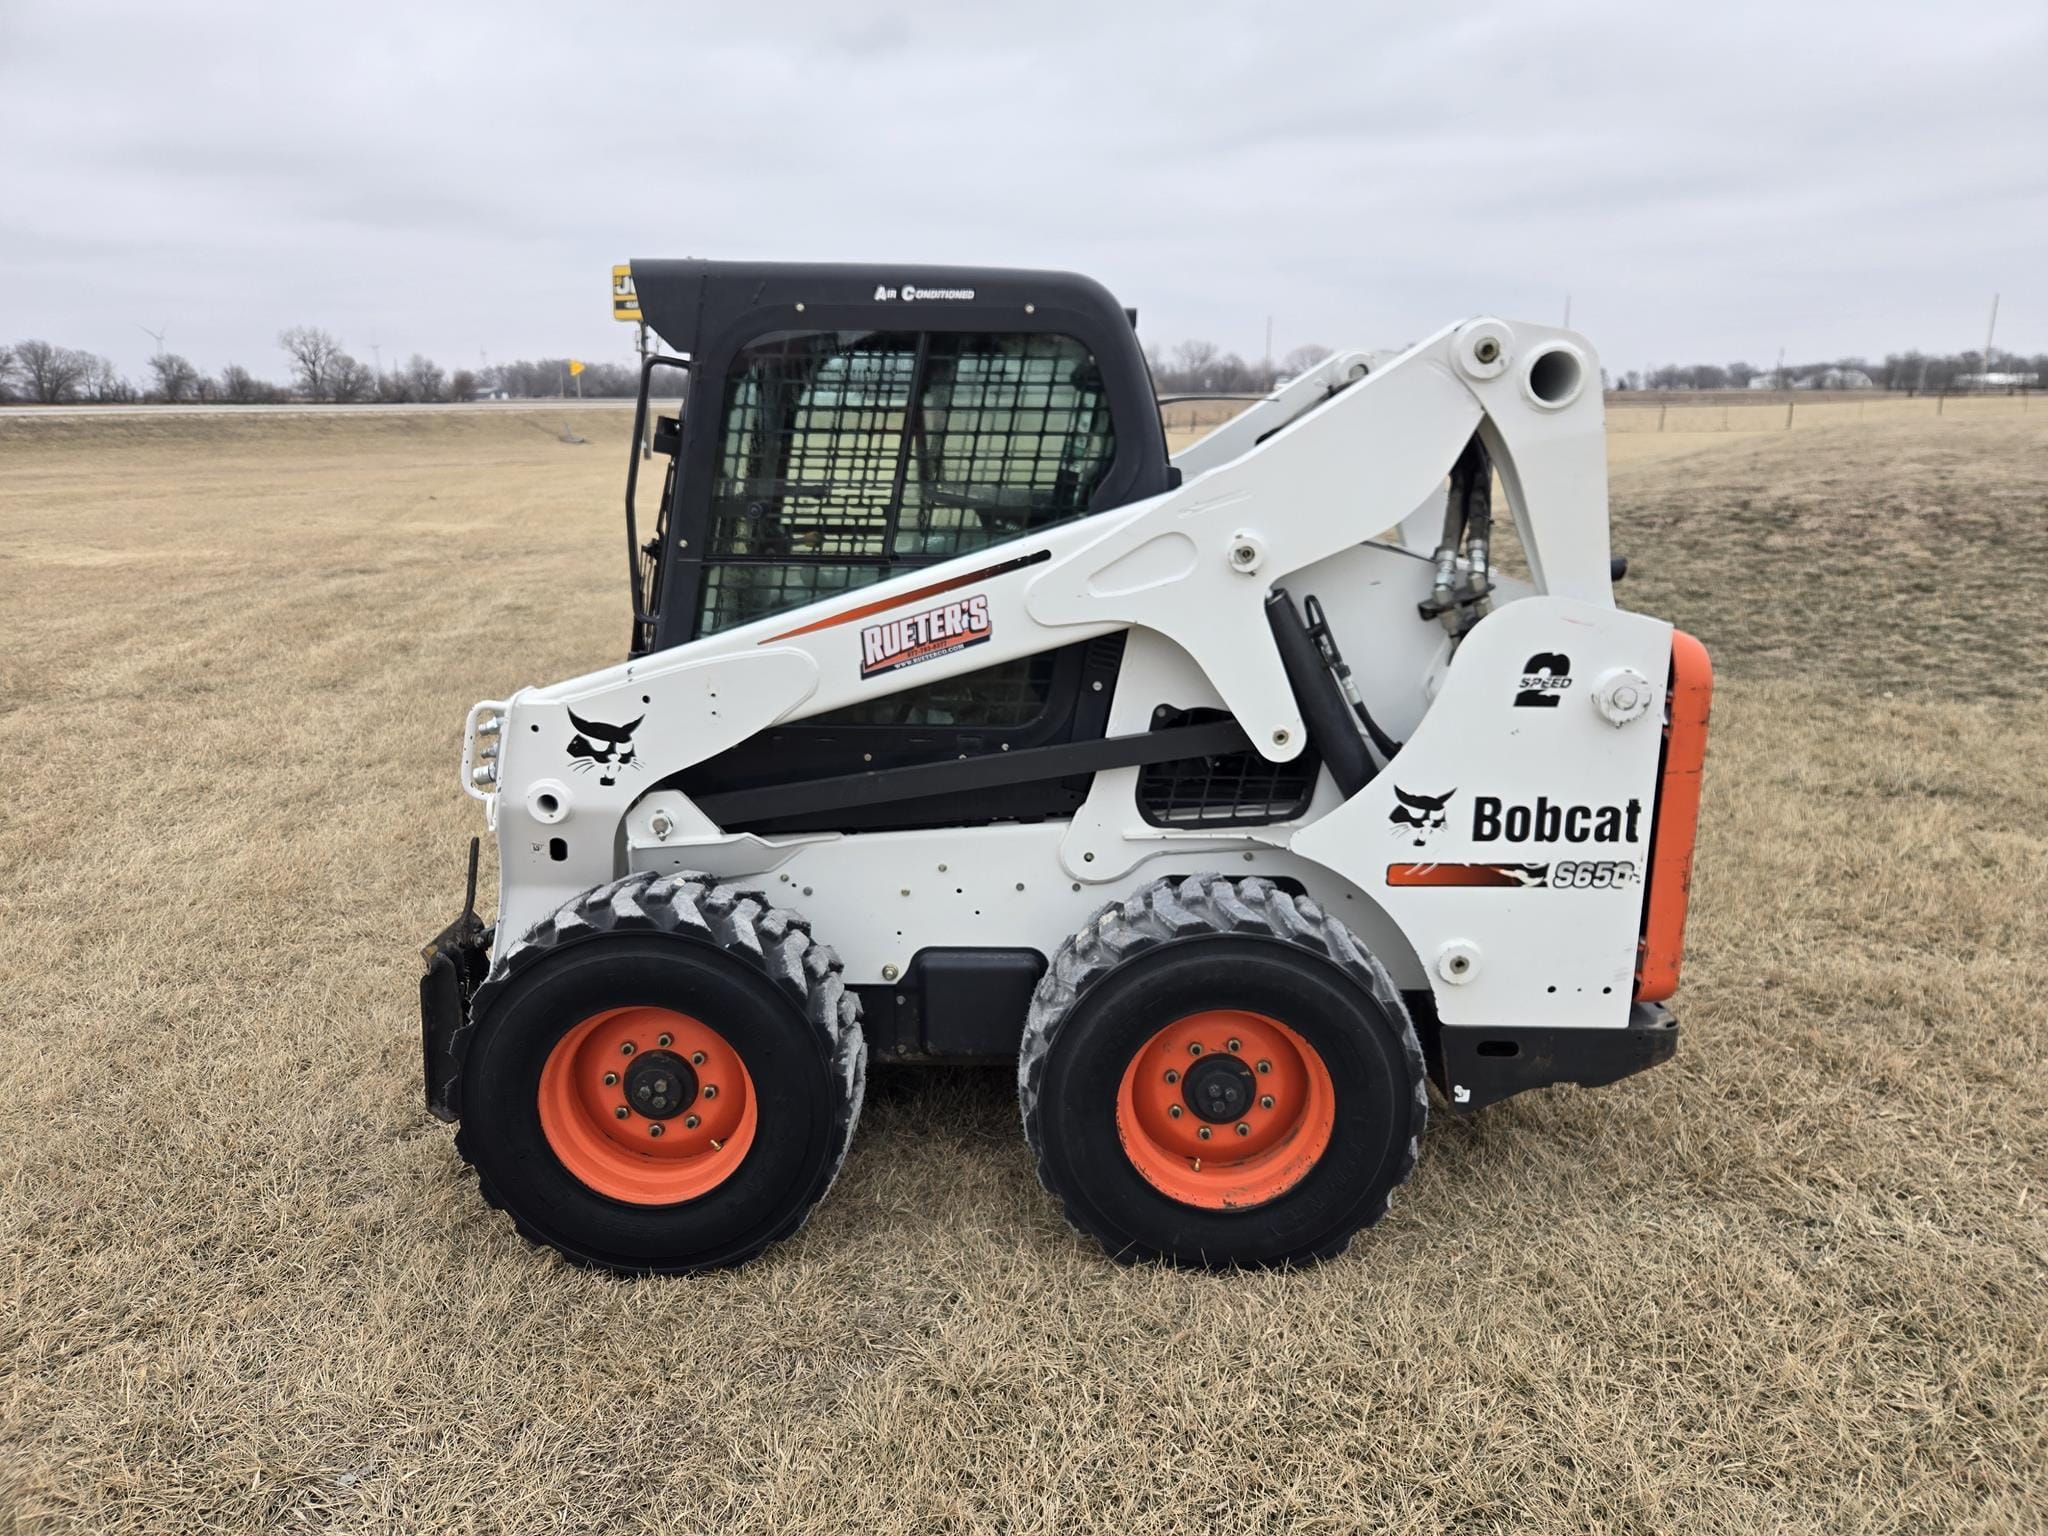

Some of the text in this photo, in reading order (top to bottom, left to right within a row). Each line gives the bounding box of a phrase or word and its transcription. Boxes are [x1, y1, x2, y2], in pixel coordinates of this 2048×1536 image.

[861, 594, 989, 668] RUETER'S
[1513, 651, 1573, 707] 2 SPEED
[1472, 796, 1642, 843] Bobcat
